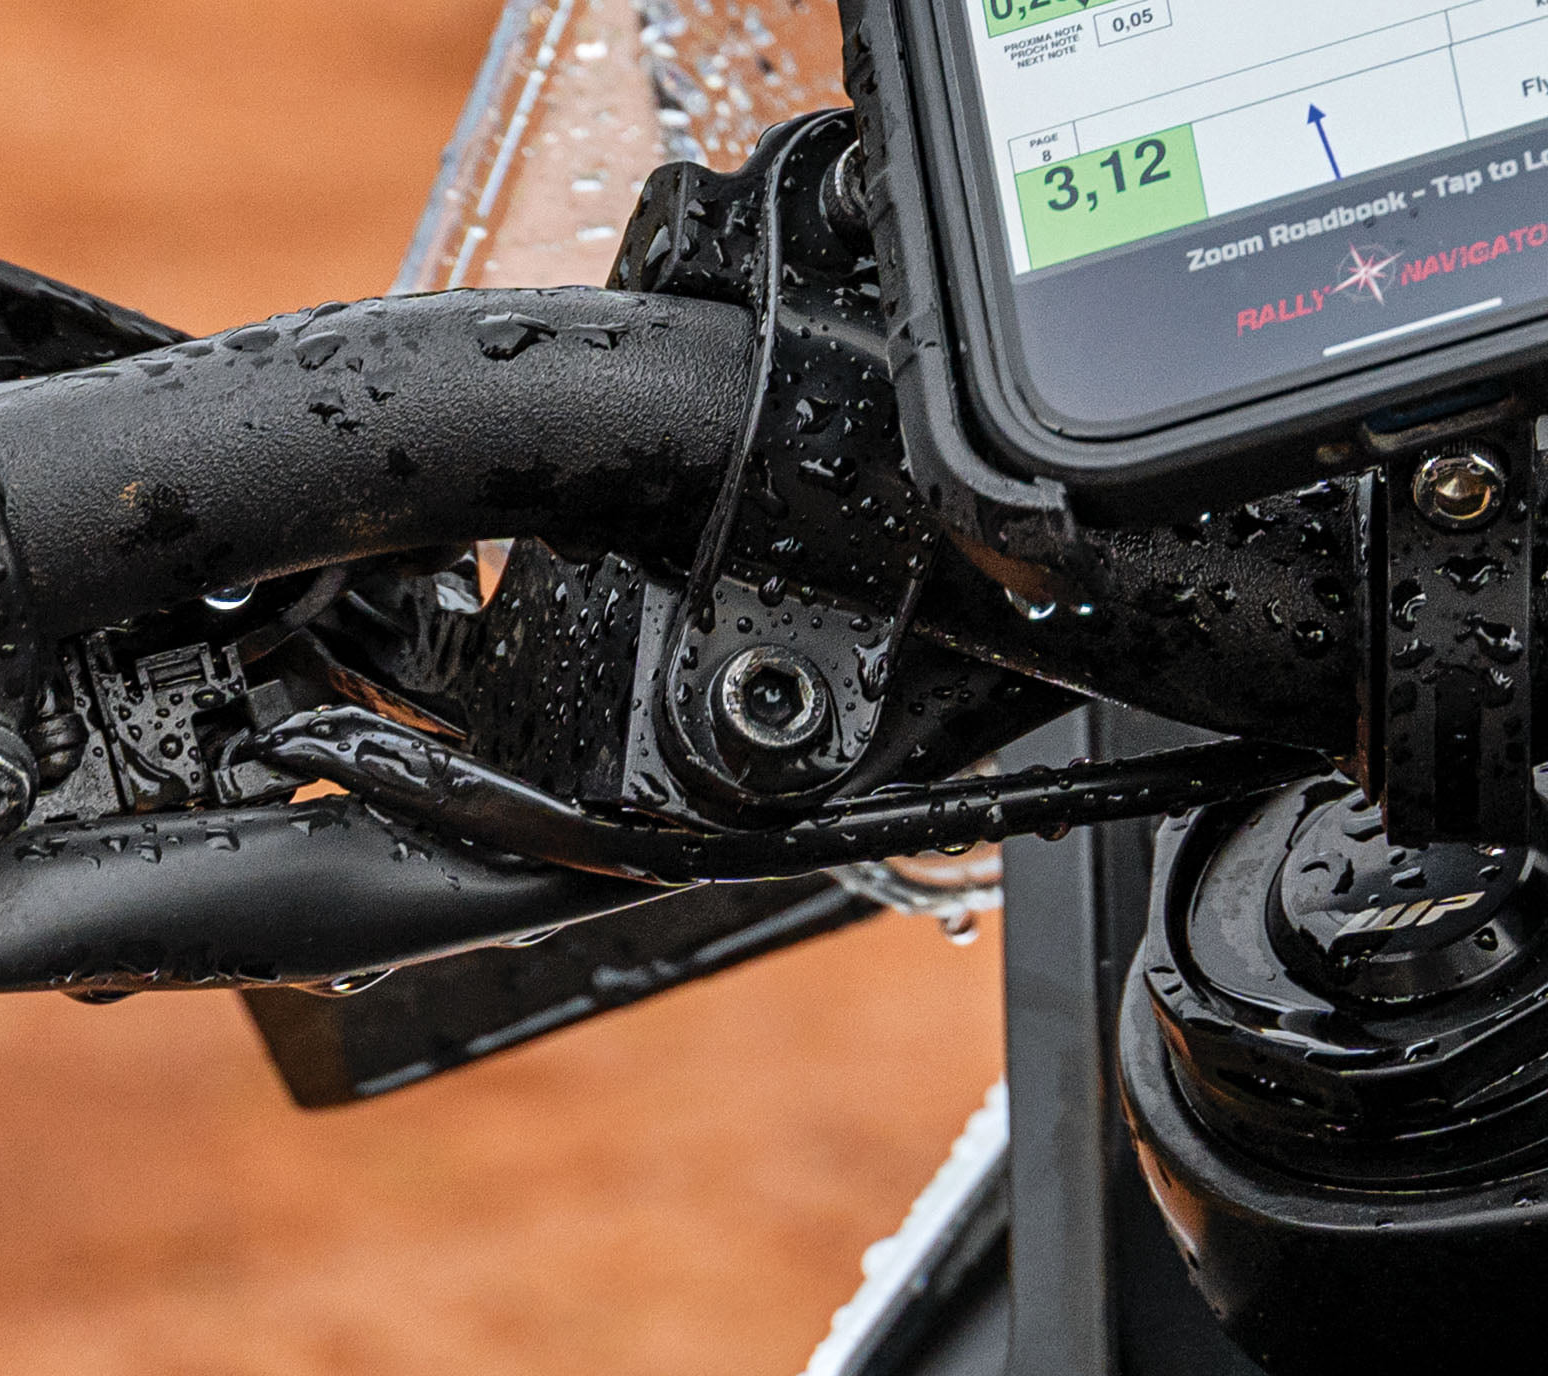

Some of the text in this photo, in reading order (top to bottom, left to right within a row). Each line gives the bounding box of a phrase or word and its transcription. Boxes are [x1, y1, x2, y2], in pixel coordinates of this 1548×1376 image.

[1112, 9, 1154, 34] 0,05
[1004, 23, 1083, 53] PROXIMA NOTA
[1051, 34, 1080, 49] NOTE
[1017, 44, 1077, 69] NEXT NOTE
[1029, 132, 1059, 149] PAGE
[1042, 149, 1052, 163] 8
[1044, 138, 1171, 212] 3,12
[1187, 234, 1265, 273] Zoom
[1269, 190, 1407, 247] Roadbook
[1430, 167, 1484, 203] Tap
[1487, 155, 1518, 180] to
[1236, 288, 1327, 338] RALLY
